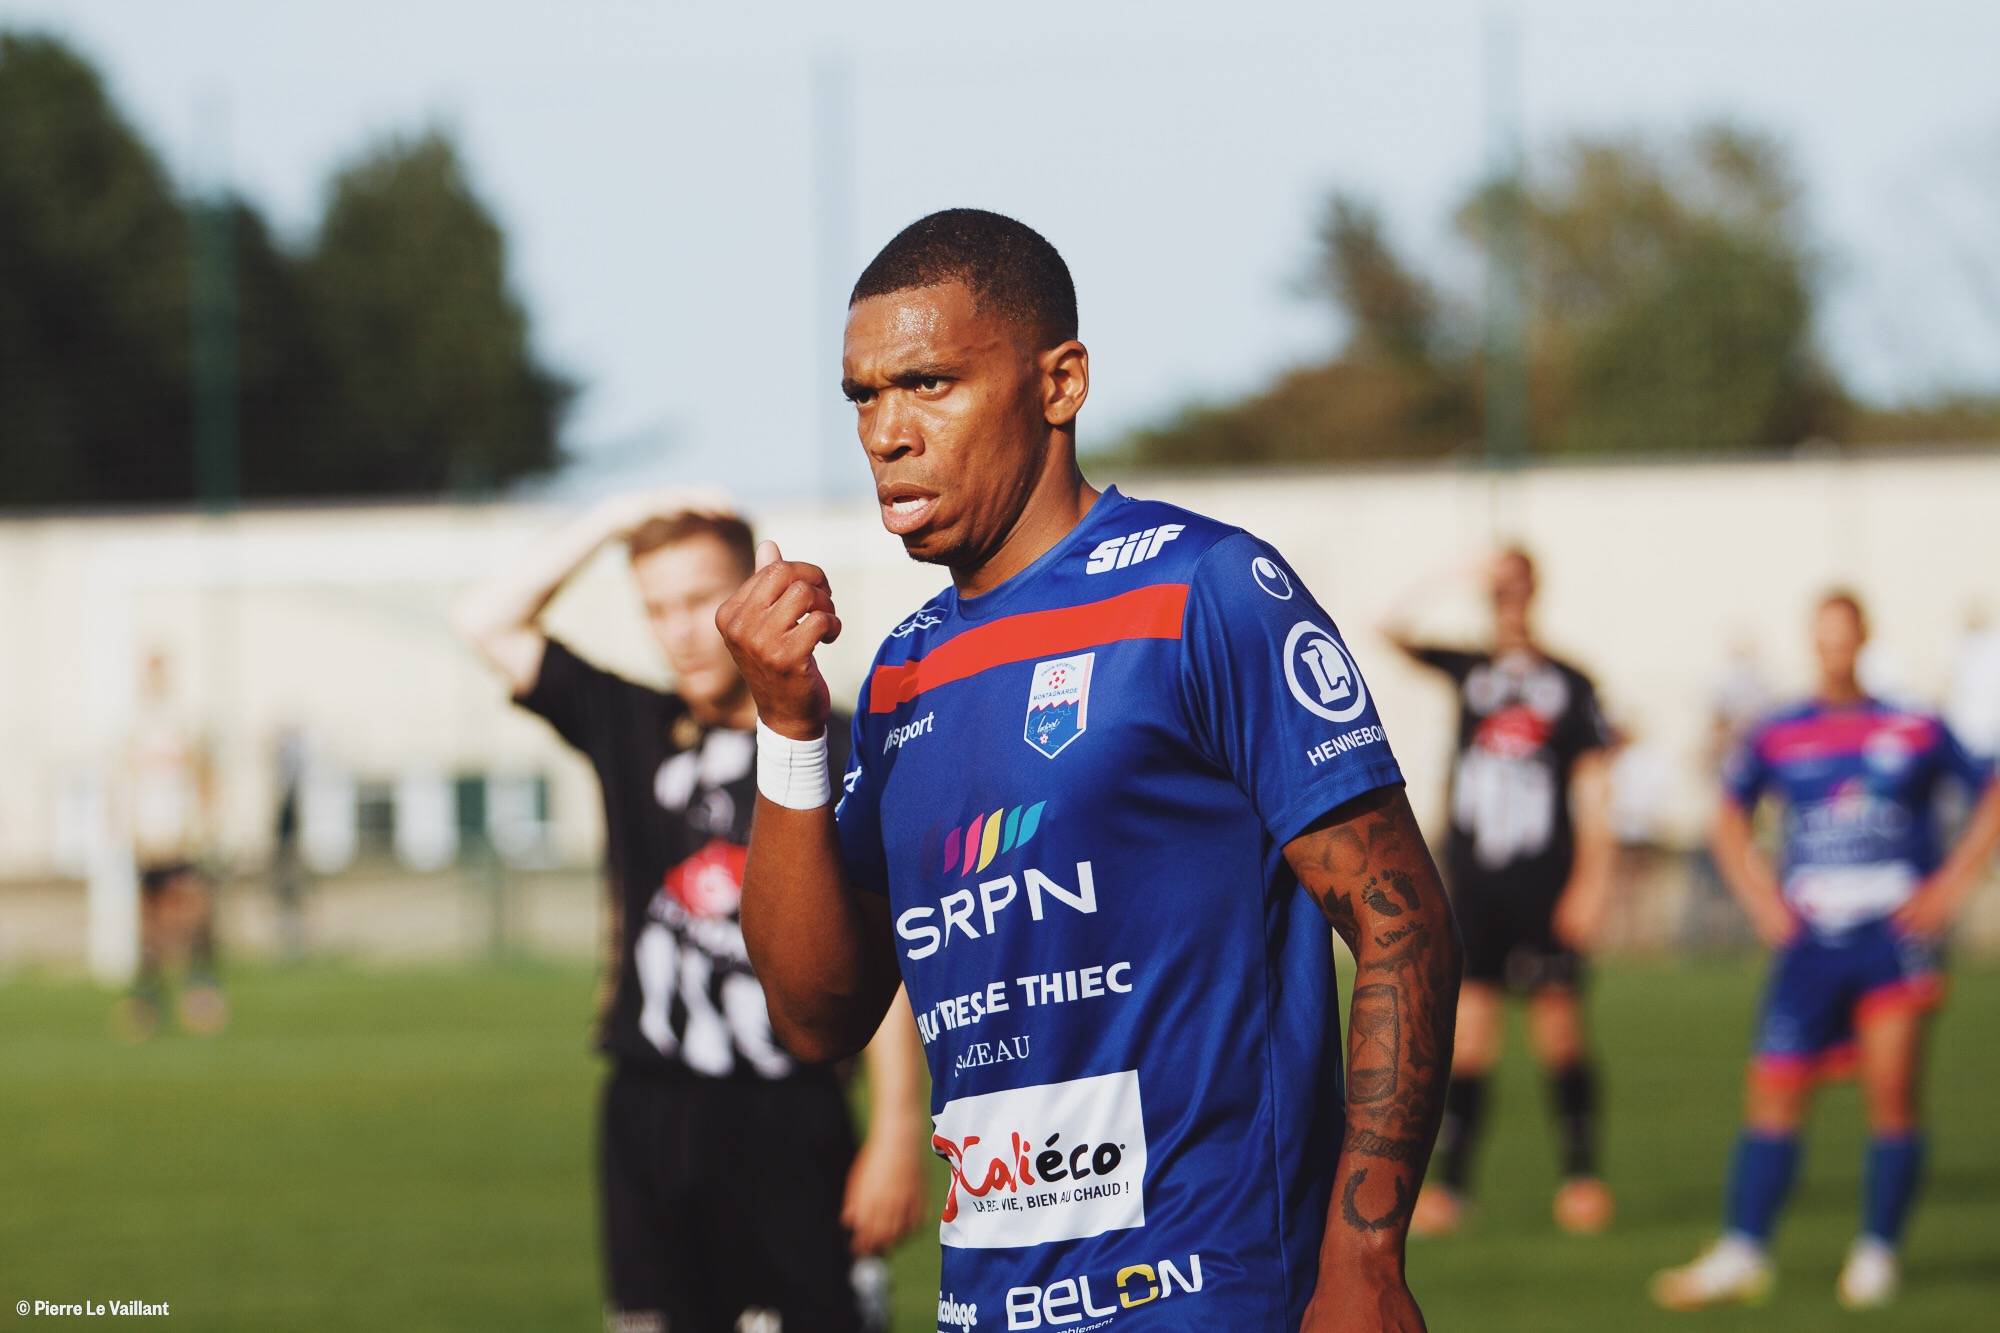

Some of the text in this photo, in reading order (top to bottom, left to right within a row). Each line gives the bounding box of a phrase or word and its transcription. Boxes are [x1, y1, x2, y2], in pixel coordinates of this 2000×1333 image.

[896, 860, 1098, 960] SRPN
[1016, 961, 1133, 1007] THIEC
[1002, 1198, 1023, 1212] VIE,
[1027, 1192, 1058, 1209] BIEN
[1060, 1190, 1072, 1205] AU
[1073, 1182, 1121, 1202] CHAUD
